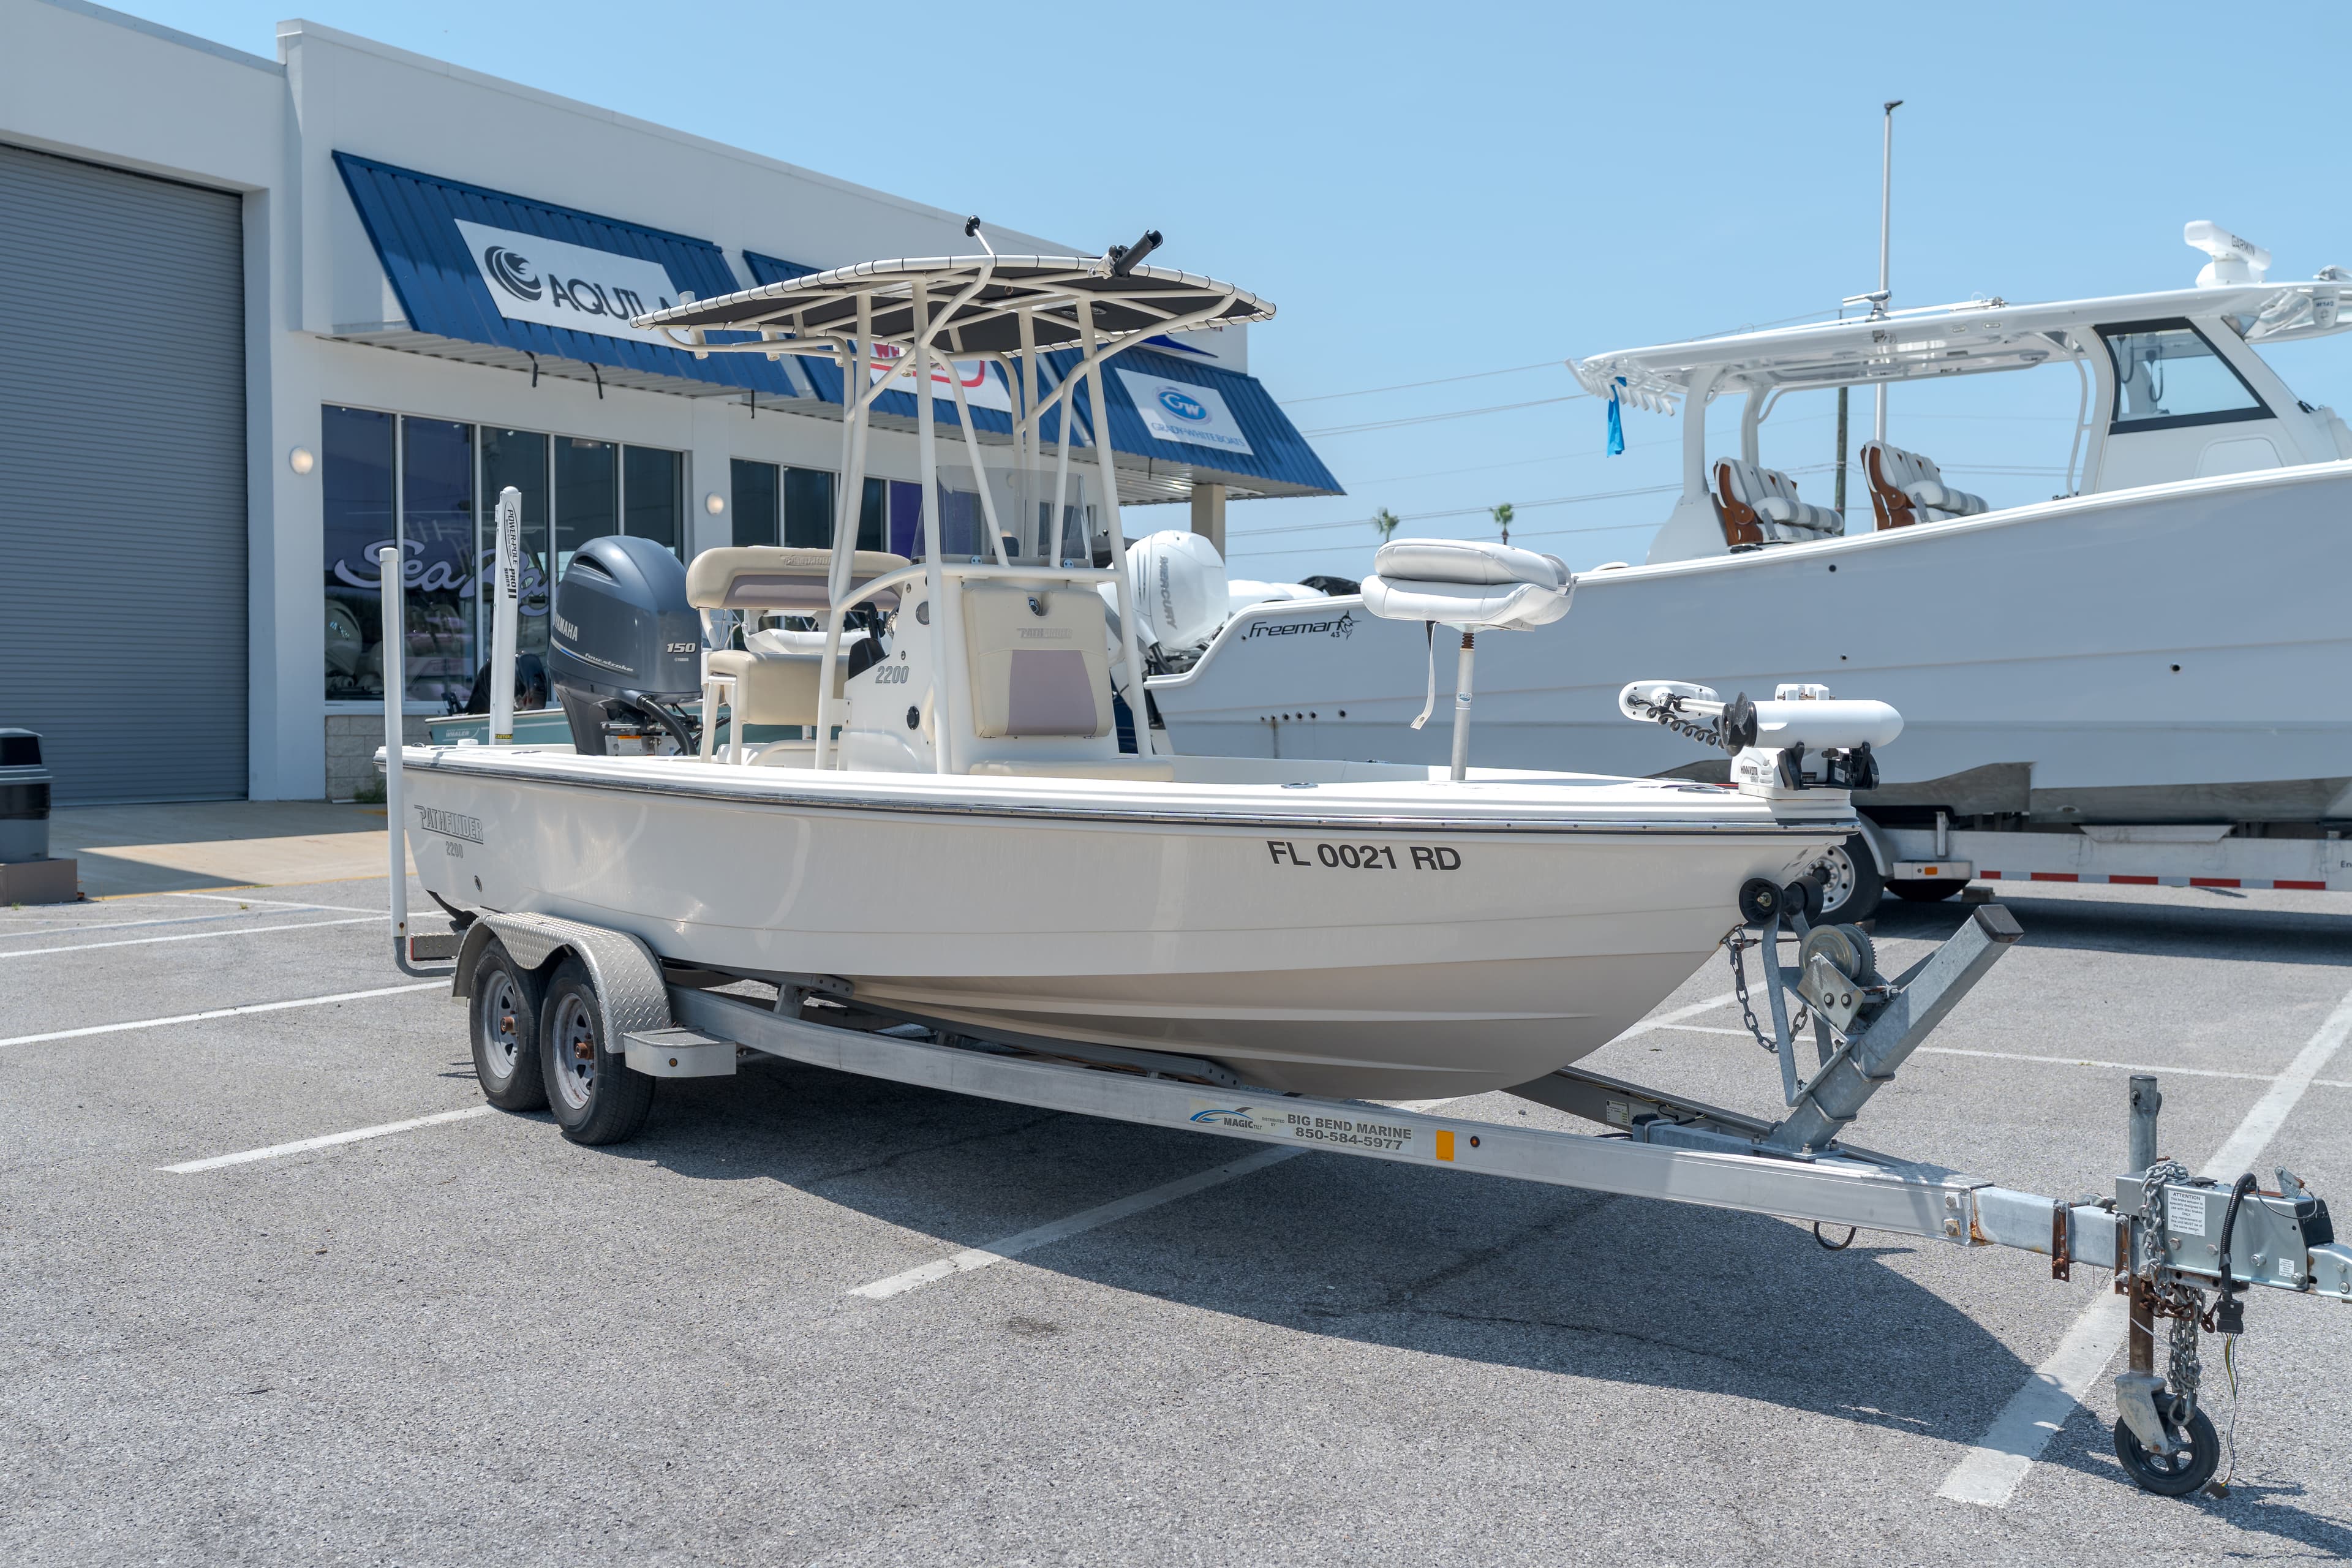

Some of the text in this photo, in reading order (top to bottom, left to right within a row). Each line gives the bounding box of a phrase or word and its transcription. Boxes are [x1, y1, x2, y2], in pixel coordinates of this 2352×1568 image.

[2232, 235, 2255, 255] GARMIN
[507, 509, 518, 565] POWER-POLE
[334, 538, 467, 592] Sea
[1159, 554, 1178, 630] MERCURY
[554, 613, 579, 642] YAMAHA
[666, 643, 696, 653] 150
[875, 665, 910, 684] 2200
[414, 804, 484, 842] PATHFINDER
[445, 841, 464, 859] 2200
[1267, 840, 1462, 870] FL 0021 RD
[1287, 1114, 1412, 1139] BIG BEND MARINE
[1295, 1127, 1403, 1150] 850-584-5977
[2173, 1192, 2201, 1200] ATTENTION
